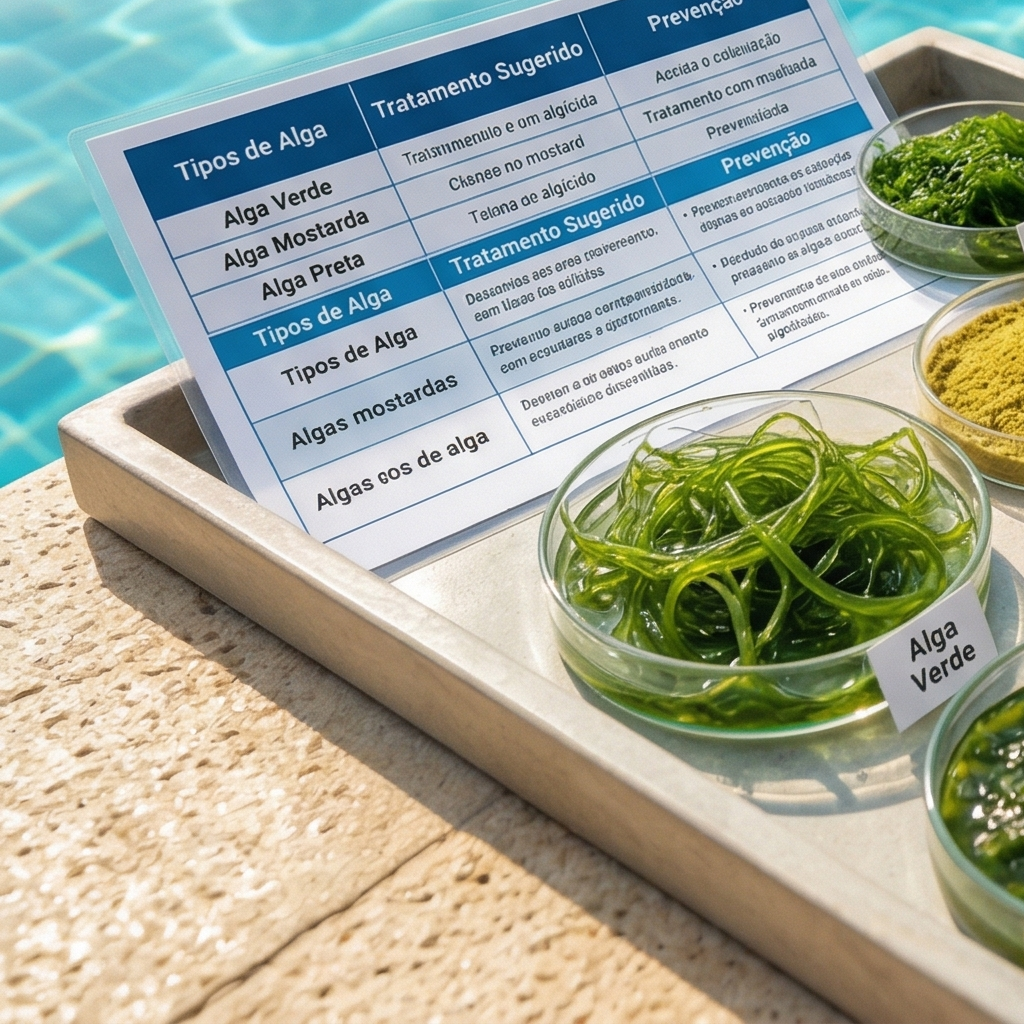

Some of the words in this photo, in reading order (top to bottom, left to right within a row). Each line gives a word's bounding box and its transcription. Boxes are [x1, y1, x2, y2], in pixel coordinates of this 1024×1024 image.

[370, 71, 492, 119] Tratamento
[494, 41, 583, 80] Sugerido
[701, 56, 711, 68] o
[505, 121, 515, 133] e
[543, 94, 598, 121] algícida
[642, 89, 723, 124] Tratamento
[724, 79, 755, 97] com
[173, 150, 241, 181] Tipos
[244, 138, 273, 160] de
[279, 124, 328, 151] Alga
[504, 158, 523, 174] no
[525, 133, 585, 166] mostard
[720, 131, 811, 175] Prevenção
[224, 203, 270, 229] Alga
[270, 180, 333, 211] Verde
[541, 171, 596, 200] algícido
[224, 245, 270, 272] Alga
[271, 209, 370, 254] Mostarda
[448, 225, 562, 275] Tratamento
[563, 193, 645, 233] Sugerido
[262, 274, 308, 301] Alga
[308, 253, 365, 283] Preta
[252, 317, 314, 347] Tipos
[317, 305, 344, 325] de
[348, 288, 393, 315] Alga
[280, 356, 341, 386] Tipos
[344, 344, 370, 364] de
[374, 327, 418, 354] Alga
[292, 417, 349, 451] Algas
[352, 374, 458, 425] mostardas
[317, 478, 375, 512] Algas
[417, 449, 443, 469] de
[446, 431, 490, 457] alga
[910, 621, 959, 663] Alga
[910, 644, 976, 693] Verde
